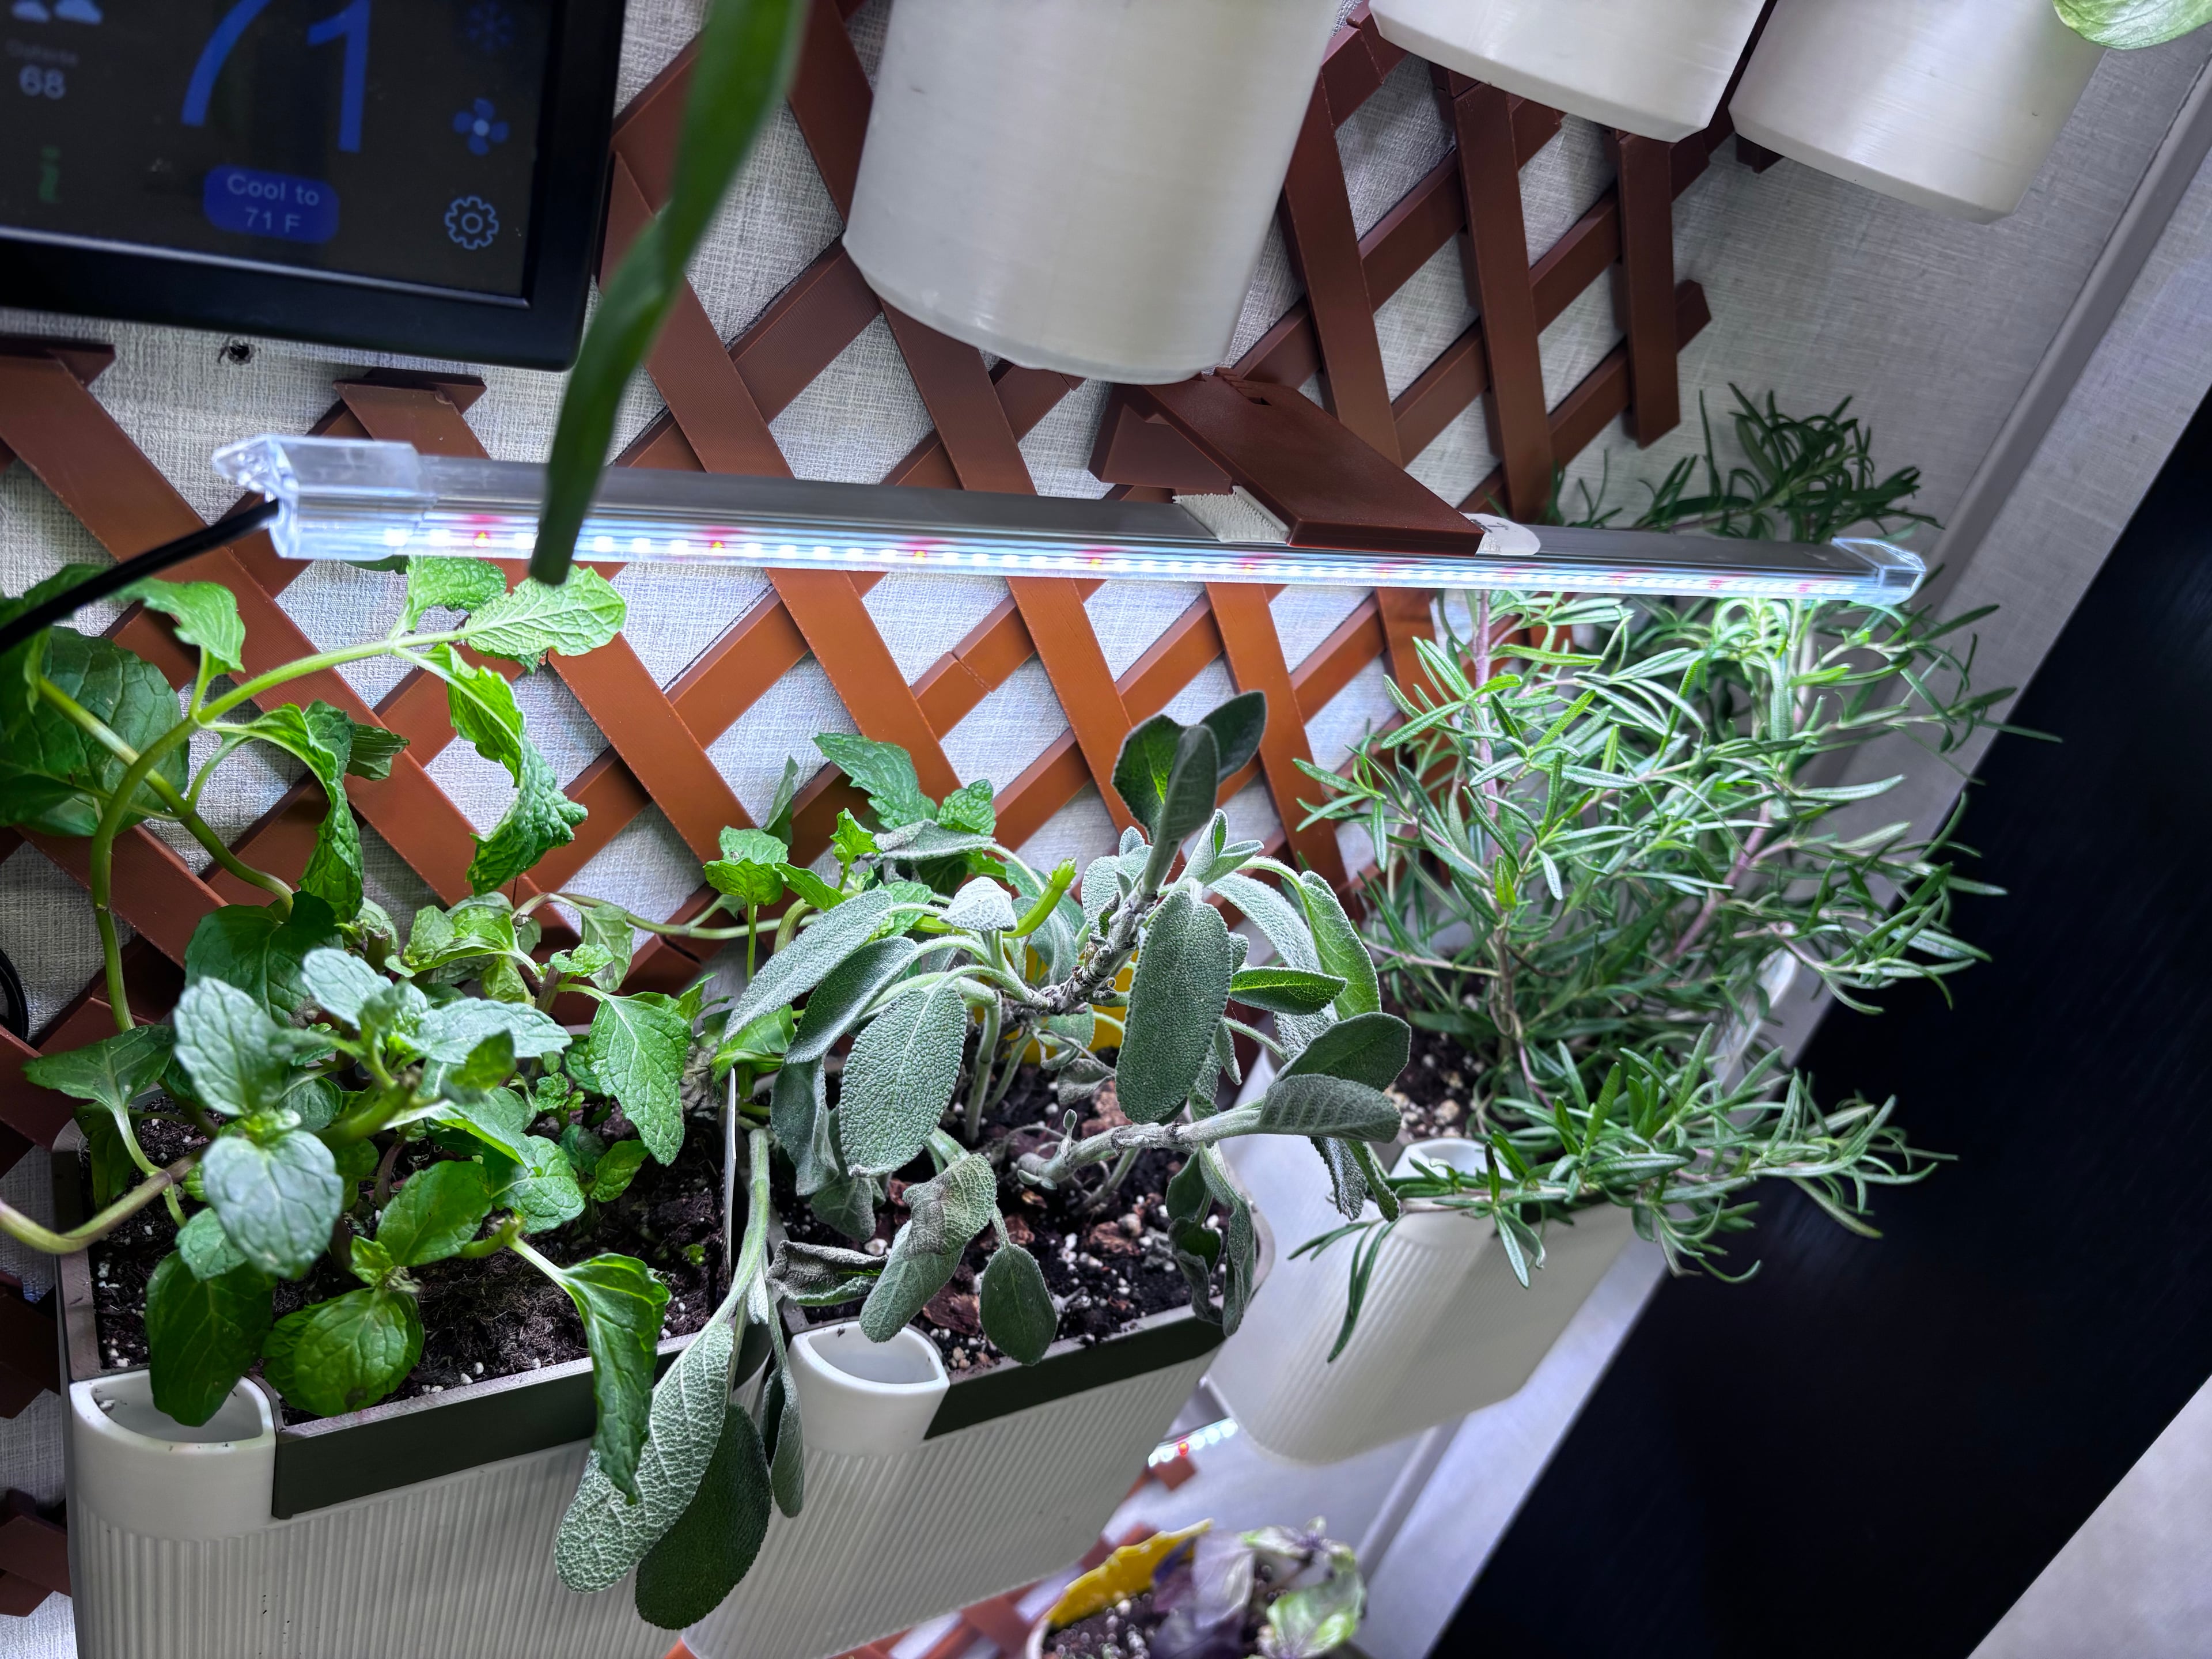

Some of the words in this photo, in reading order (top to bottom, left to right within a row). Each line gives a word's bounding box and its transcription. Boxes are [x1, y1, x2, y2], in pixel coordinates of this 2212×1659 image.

[19, 65, 66, 99] 68
[227, 173, 286, 202] Cool
[296, 184, 320, 206] to
[245, 206, 272, 230] 71
[285, 213, 301, 233] F
